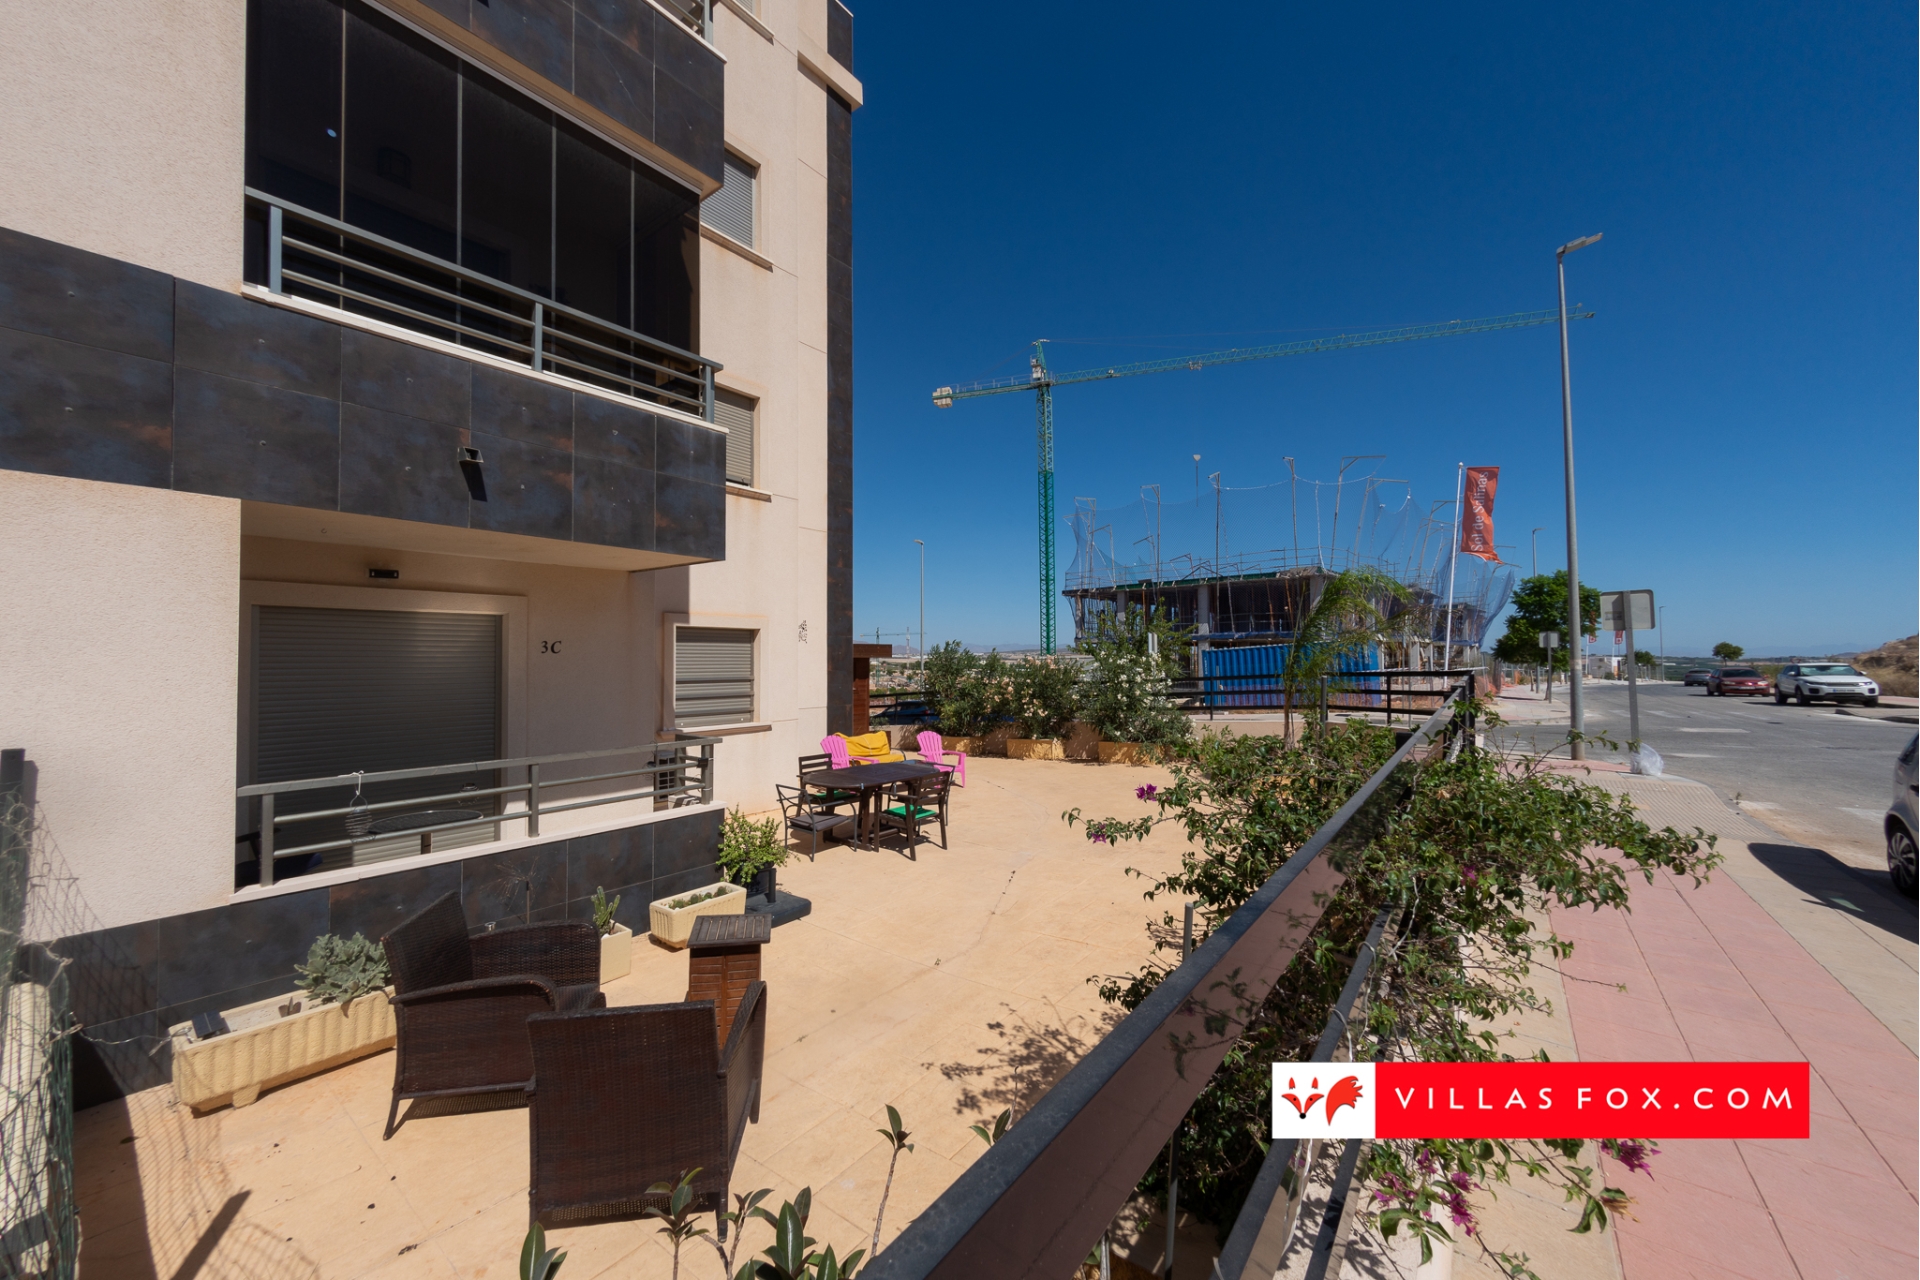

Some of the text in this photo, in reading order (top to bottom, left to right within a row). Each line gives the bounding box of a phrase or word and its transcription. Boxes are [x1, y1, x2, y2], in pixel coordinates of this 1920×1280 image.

[1471, 471, 1489, 552] Sol de Salinas
[540, 640, 562, 654] 3C
